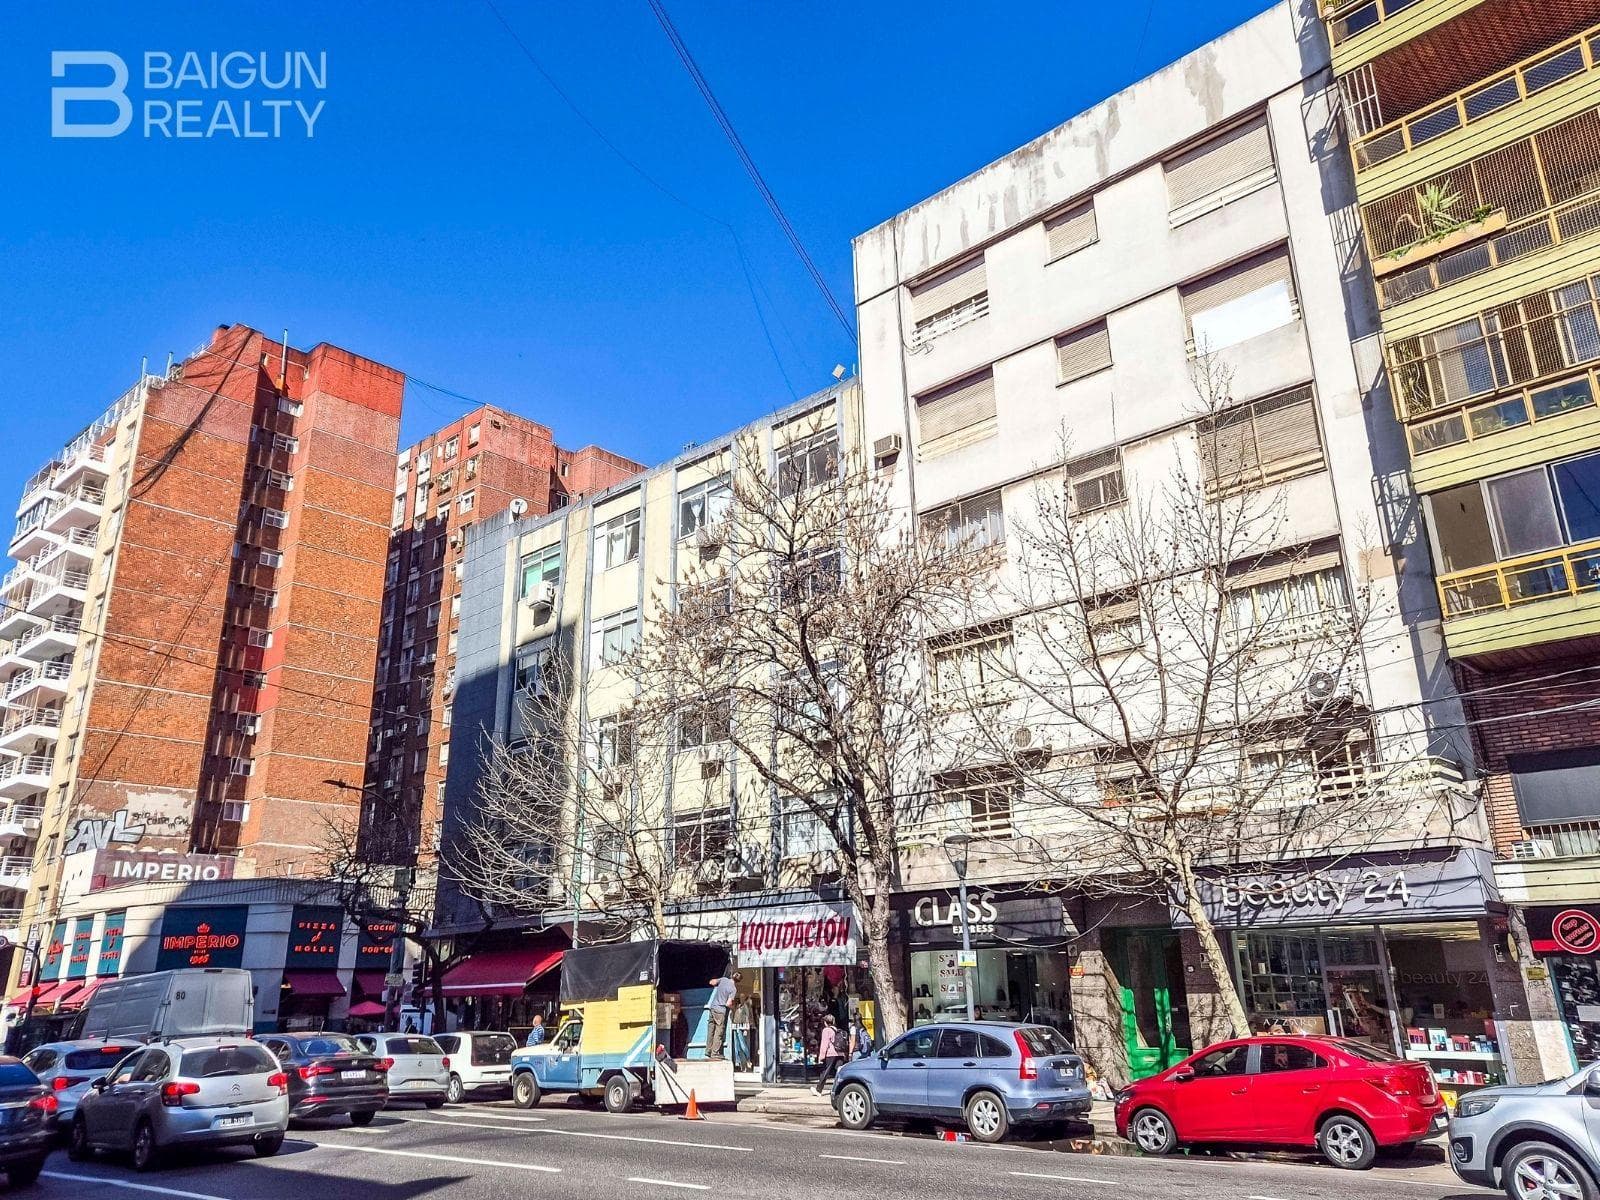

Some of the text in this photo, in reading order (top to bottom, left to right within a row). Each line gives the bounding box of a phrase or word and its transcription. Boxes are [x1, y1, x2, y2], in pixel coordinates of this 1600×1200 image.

[112, 860, 220, 881] IMPERIO
[1221, 871, 1412, 911] beauty 24
[914, 891, 998, 926] CLASS
[298, 922, 336, 930] PIZZA
[952, 924, 994, 934] EXRESS
[163, 934, 240, 950] IMPERIO
[294, 945, 335, 953] MOLDE
[1402, 970, 1489, 988] beauty 24
[175, 990, 186, 1000] 80
